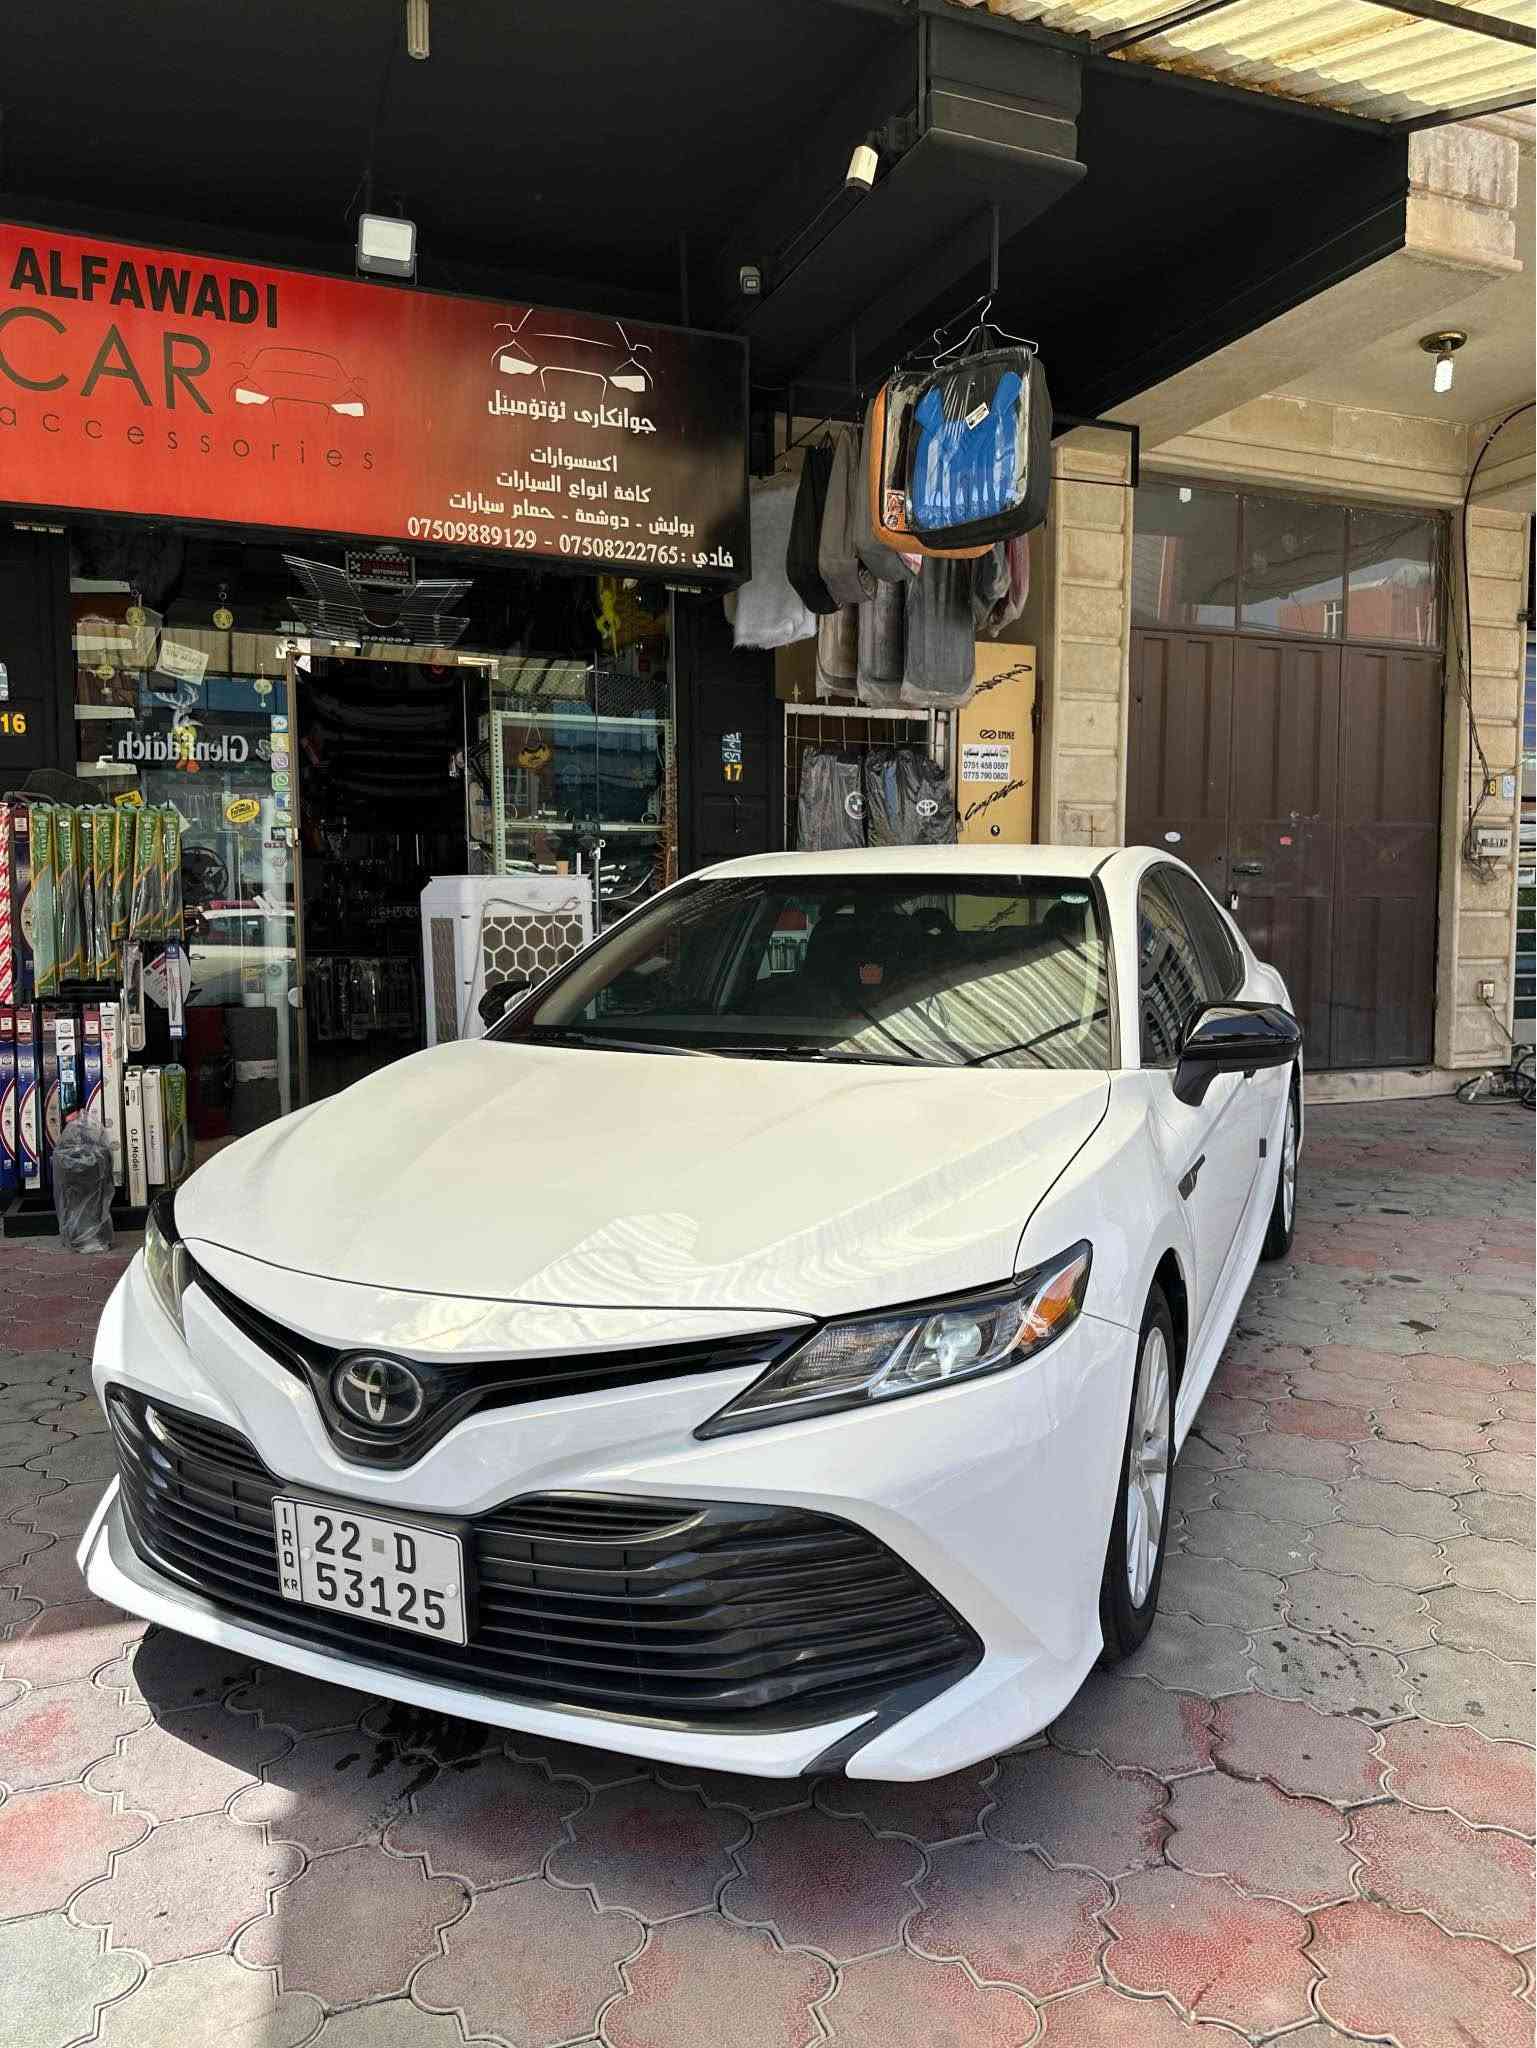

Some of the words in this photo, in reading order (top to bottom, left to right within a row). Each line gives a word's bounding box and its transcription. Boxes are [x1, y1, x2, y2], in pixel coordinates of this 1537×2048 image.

[10, 246, 278, 328] ALFAWADI
[0, 306, 214, 414] CAR
[0, 406, 375, 470] accessories
[530, 446, 618, 473] اكسسوارات
[496, 469, 561, 493] السيارات
[568, 478, 608, 500] انواع
[449, 491, 505, 514] سيارات
[613, 484, 652, 503] كافة
[511, 498, 555, 519] حمام
[575, 508, 630, 531] دوشمة
[407, 516, 537, 549] 07509889129
[648, 515, 695, 538] بوليش
[558, 533, 678, 565] 07508222765
[0, 712, 26, 734] 16
[724, 763, 742, 781] 17
[281, 1507, 295, 1569] IRQ
[313, 1514, 362, 1562] 22
[393, 1531, 417, 1574] D
[283, 1577, 298, 1591] KR
[316, 1561, 446, 1630] 53125
